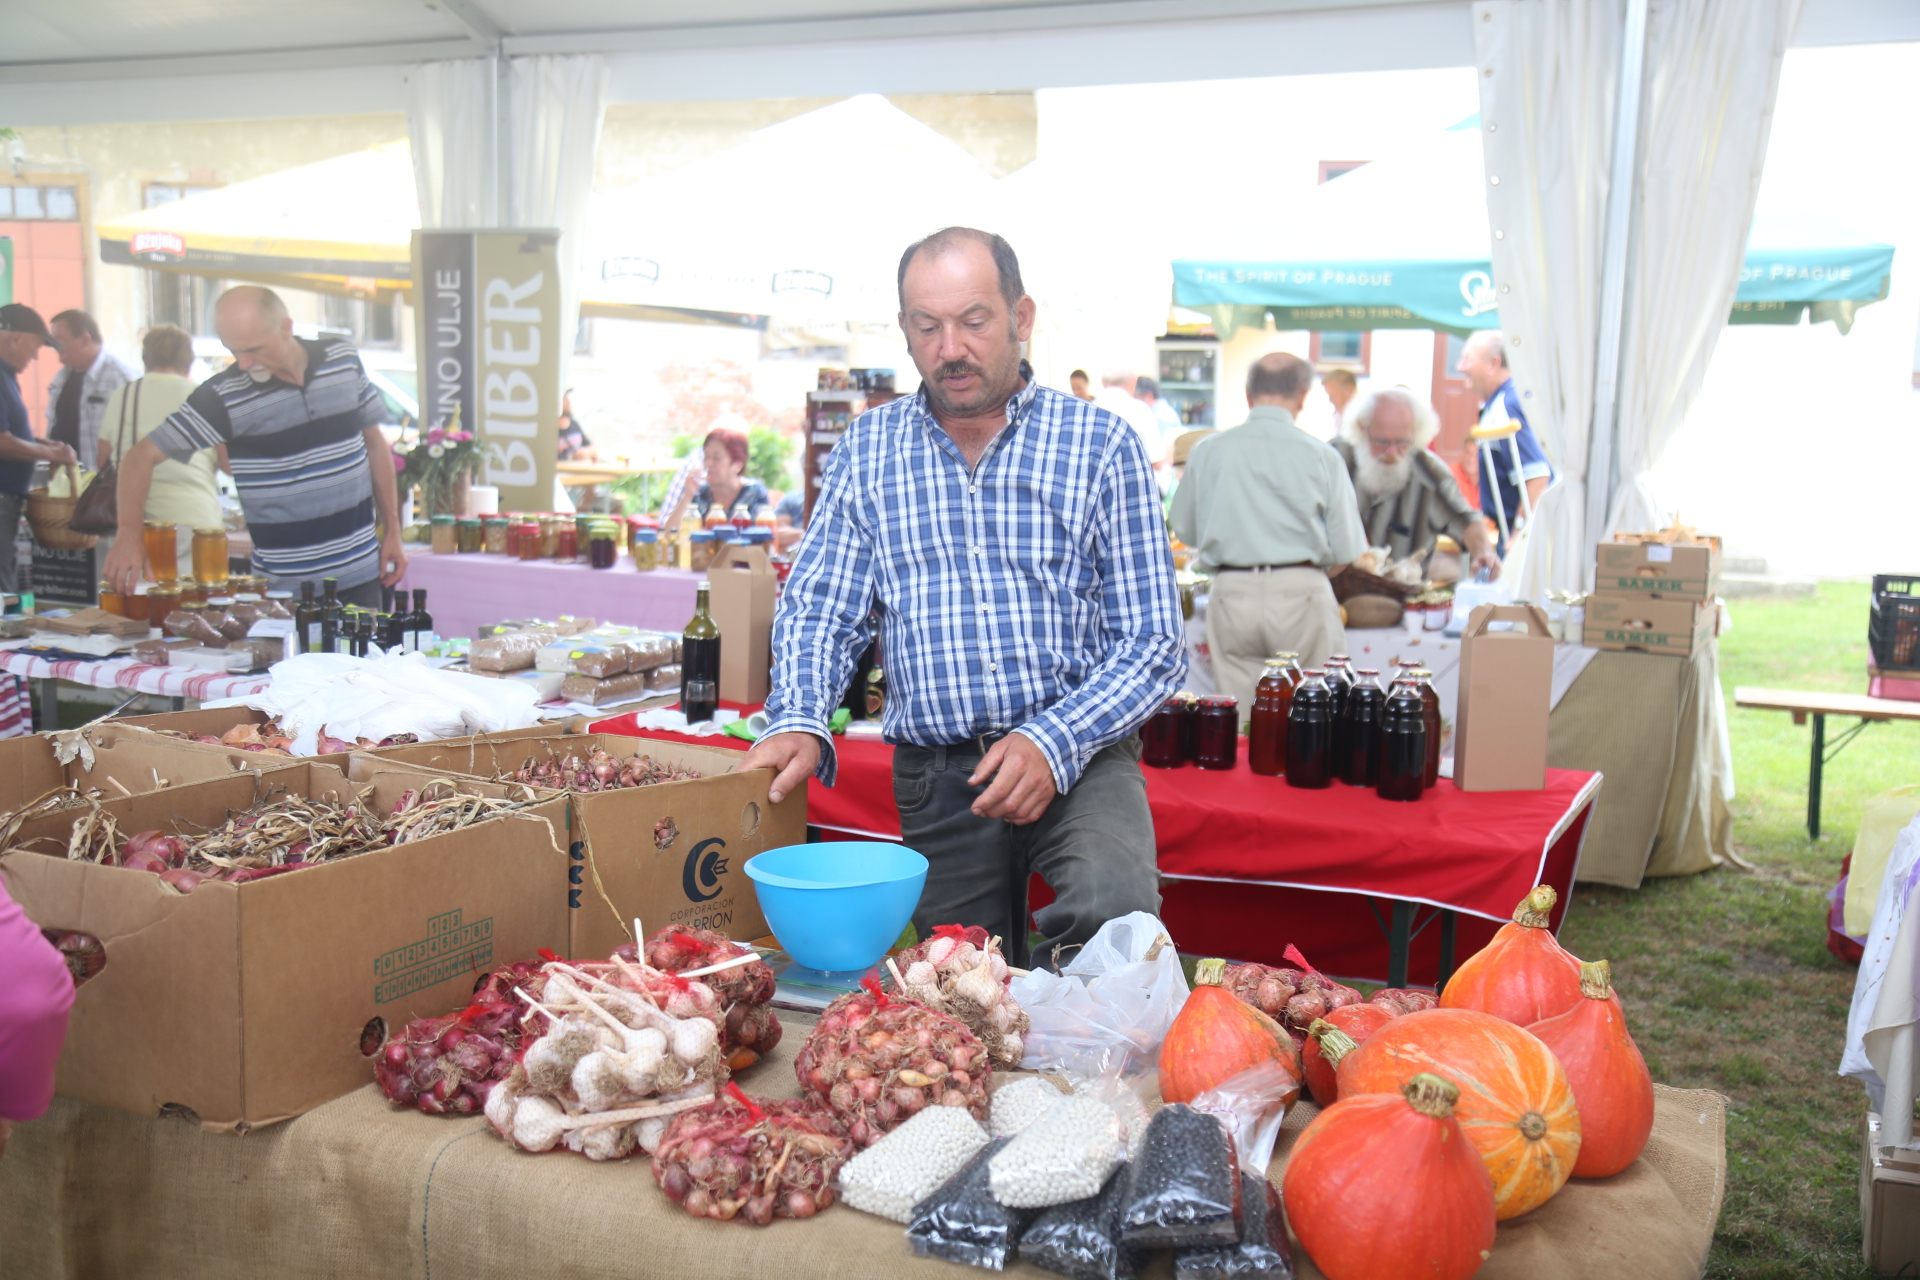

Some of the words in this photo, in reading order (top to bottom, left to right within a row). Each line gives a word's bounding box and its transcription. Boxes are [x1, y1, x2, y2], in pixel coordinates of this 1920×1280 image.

[1194, 268, 1228, 284] THE
[1233, 269, 1287, 284] SPIRIT
[1321, 269, 1393, 287] PRAGUE
[1770, 263, 1852, 282] PRAGUE
[436, 269, 462, 348] ULJE
[484, 270, 544, 488] BIBER
